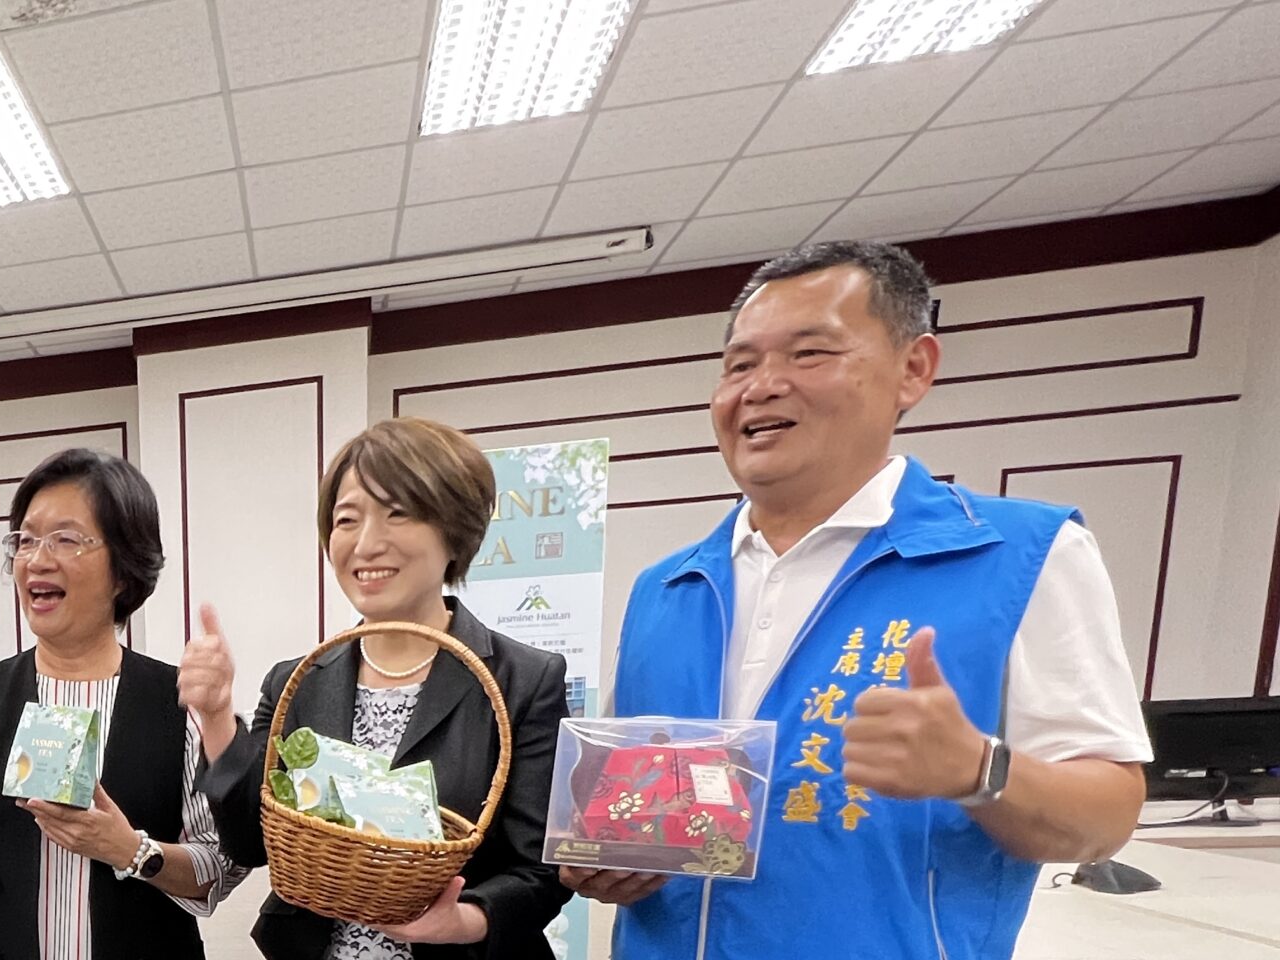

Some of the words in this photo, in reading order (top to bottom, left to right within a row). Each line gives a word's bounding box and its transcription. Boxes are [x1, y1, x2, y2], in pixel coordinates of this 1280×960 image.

[831, 627, 865, 676] 主席
[31, 738, 65, 749] JASMINE
[39, 749, 52, 757] TEA
[781, 683, 847, 822] 沈文盛
